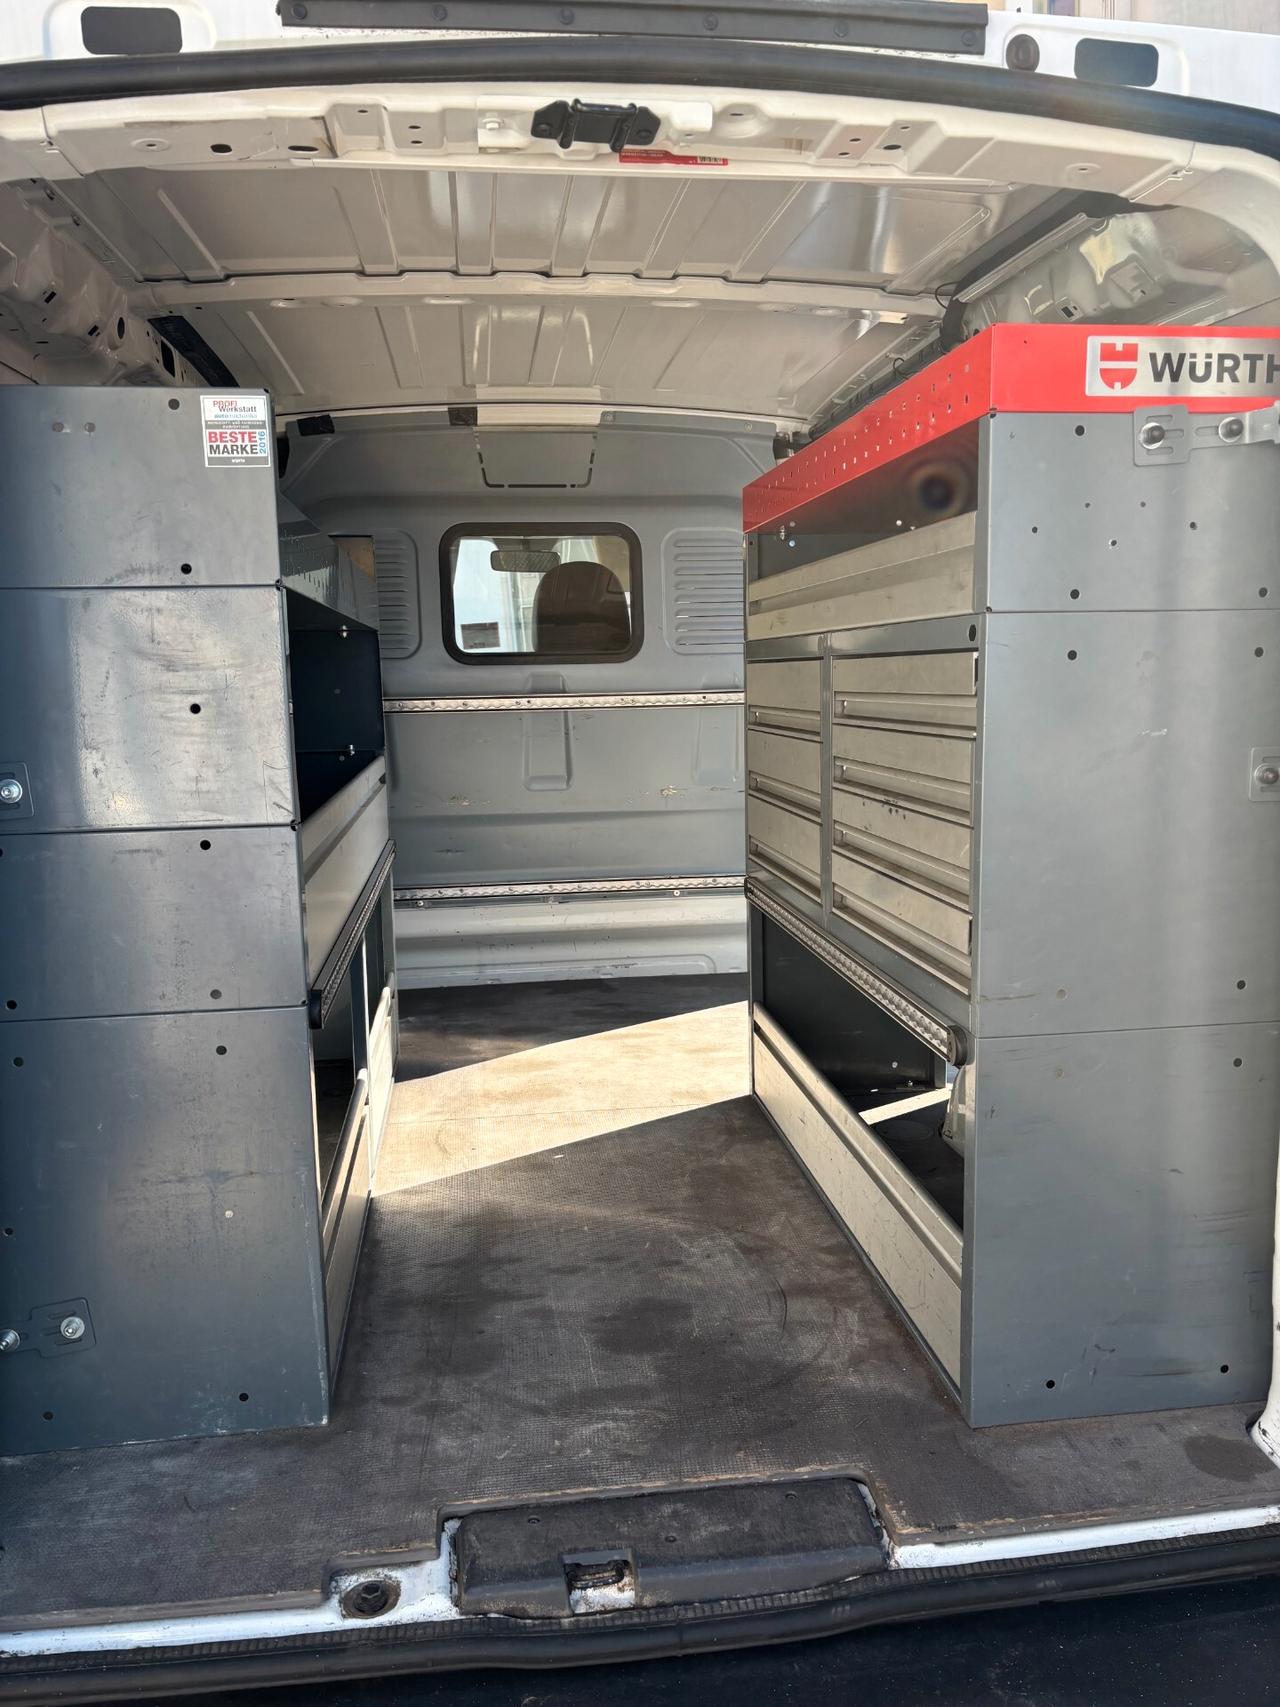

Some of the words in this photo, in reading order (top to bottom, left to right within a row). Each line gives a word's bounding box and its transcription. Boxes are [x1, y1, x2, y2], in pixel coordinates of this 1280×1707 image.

[208, 431, 257, 443] BESTE
[258, 431, 267, 454] 2016
[209, 444, 259, 455] MARKE
